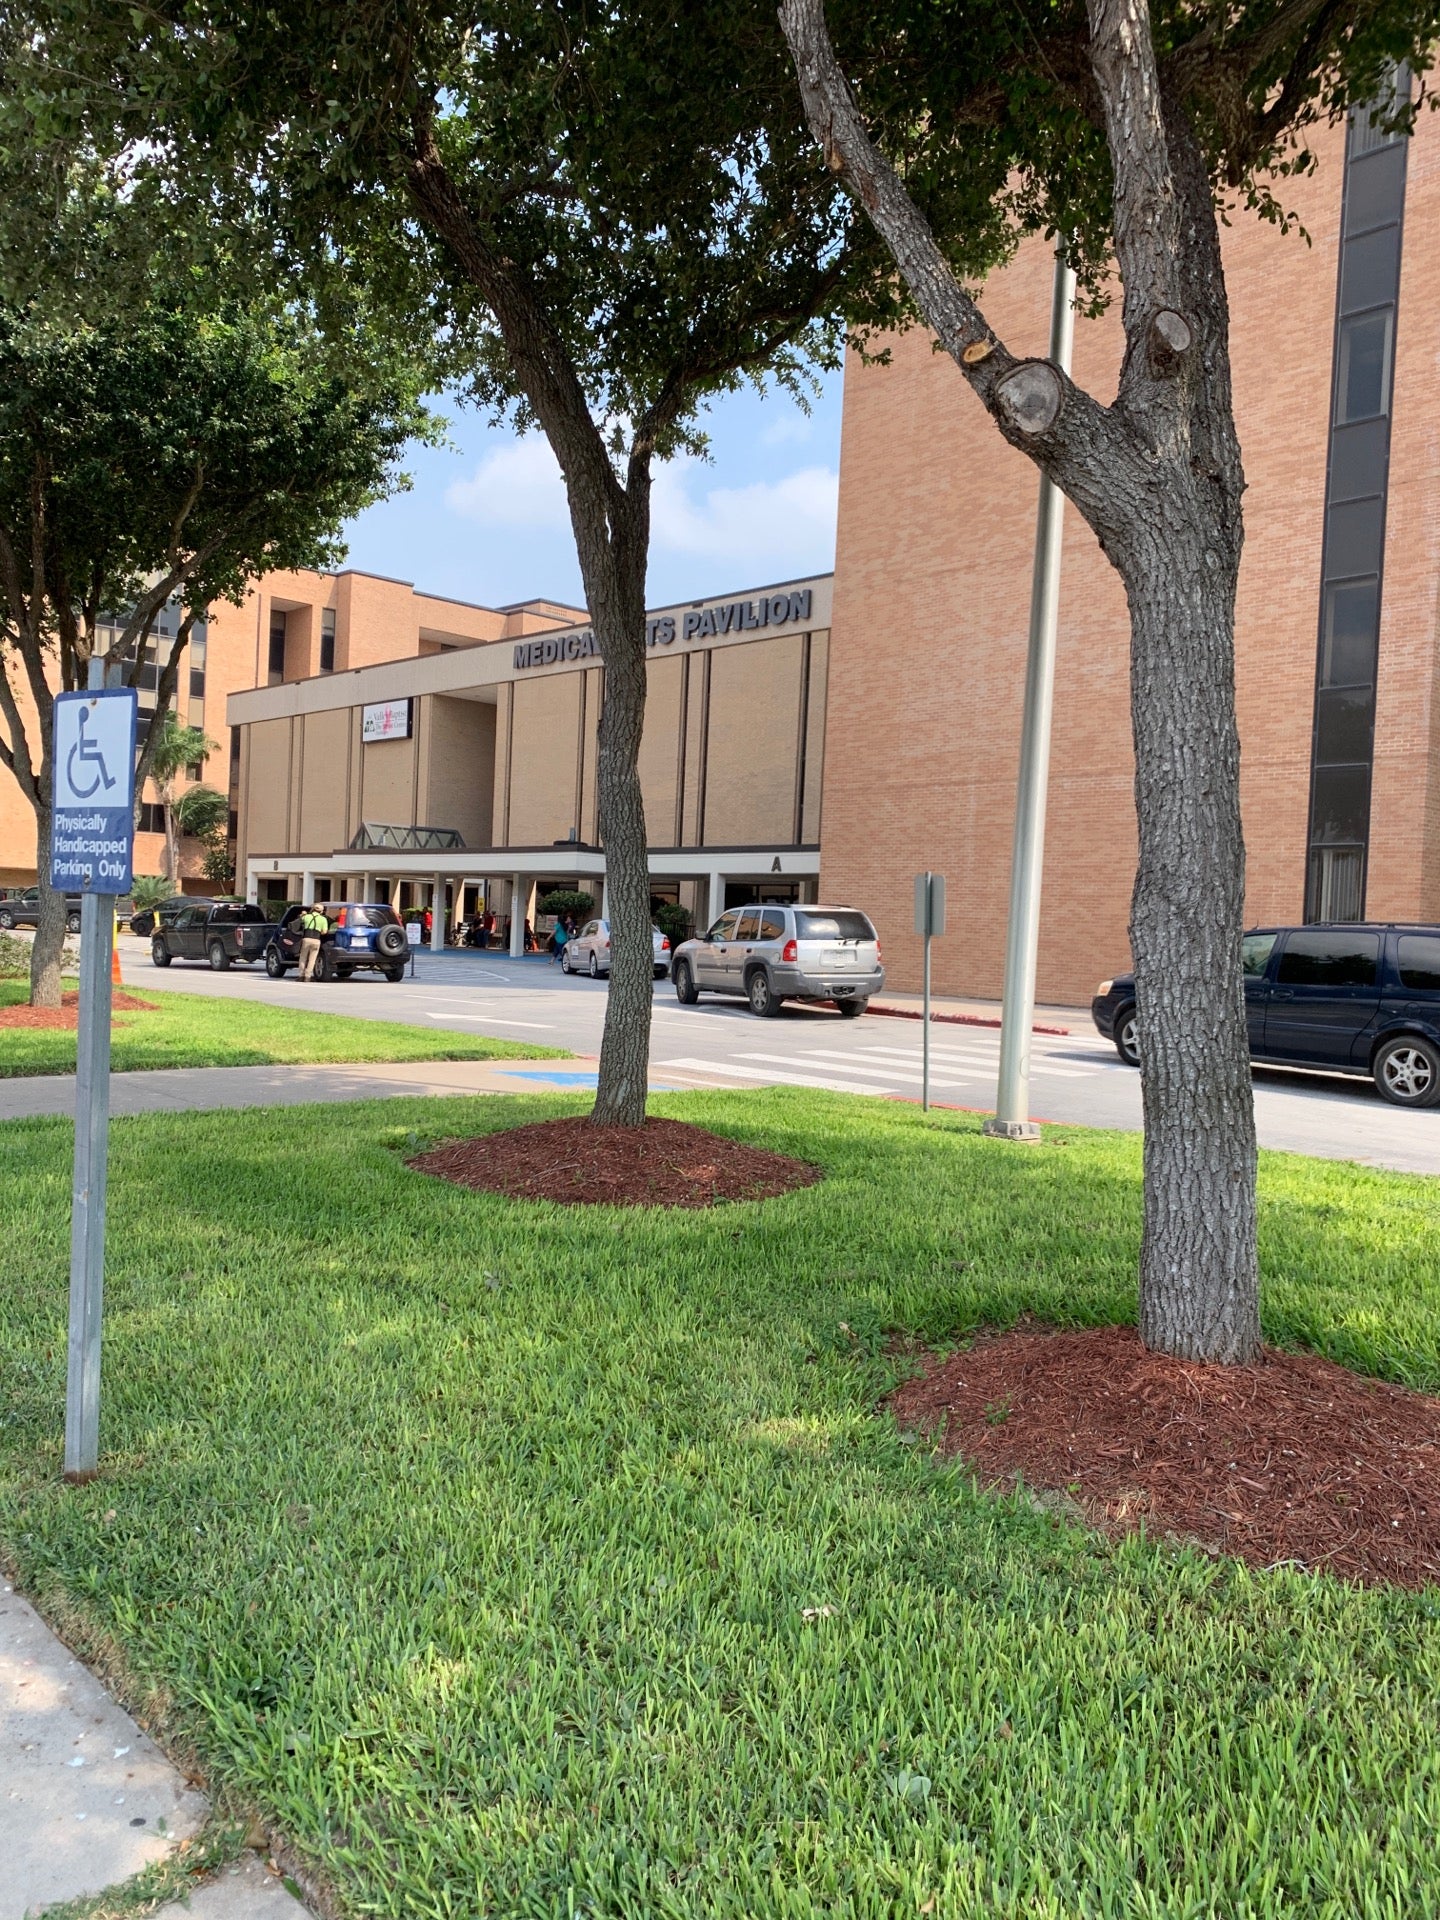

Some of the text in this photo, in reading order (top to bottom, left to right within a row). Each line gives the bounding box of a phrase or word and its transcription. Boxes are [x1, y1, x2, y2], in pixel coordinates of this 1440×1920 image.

[646, 616, 676, 646] TS
[683, 589, 812, 640] PAVILION
[55, 813, 107, 833] Physically
[54, 836, 127, 857] Handicapped
[54, 859, 126, 880] Parking Only
[771, 856, 782, 872] A
